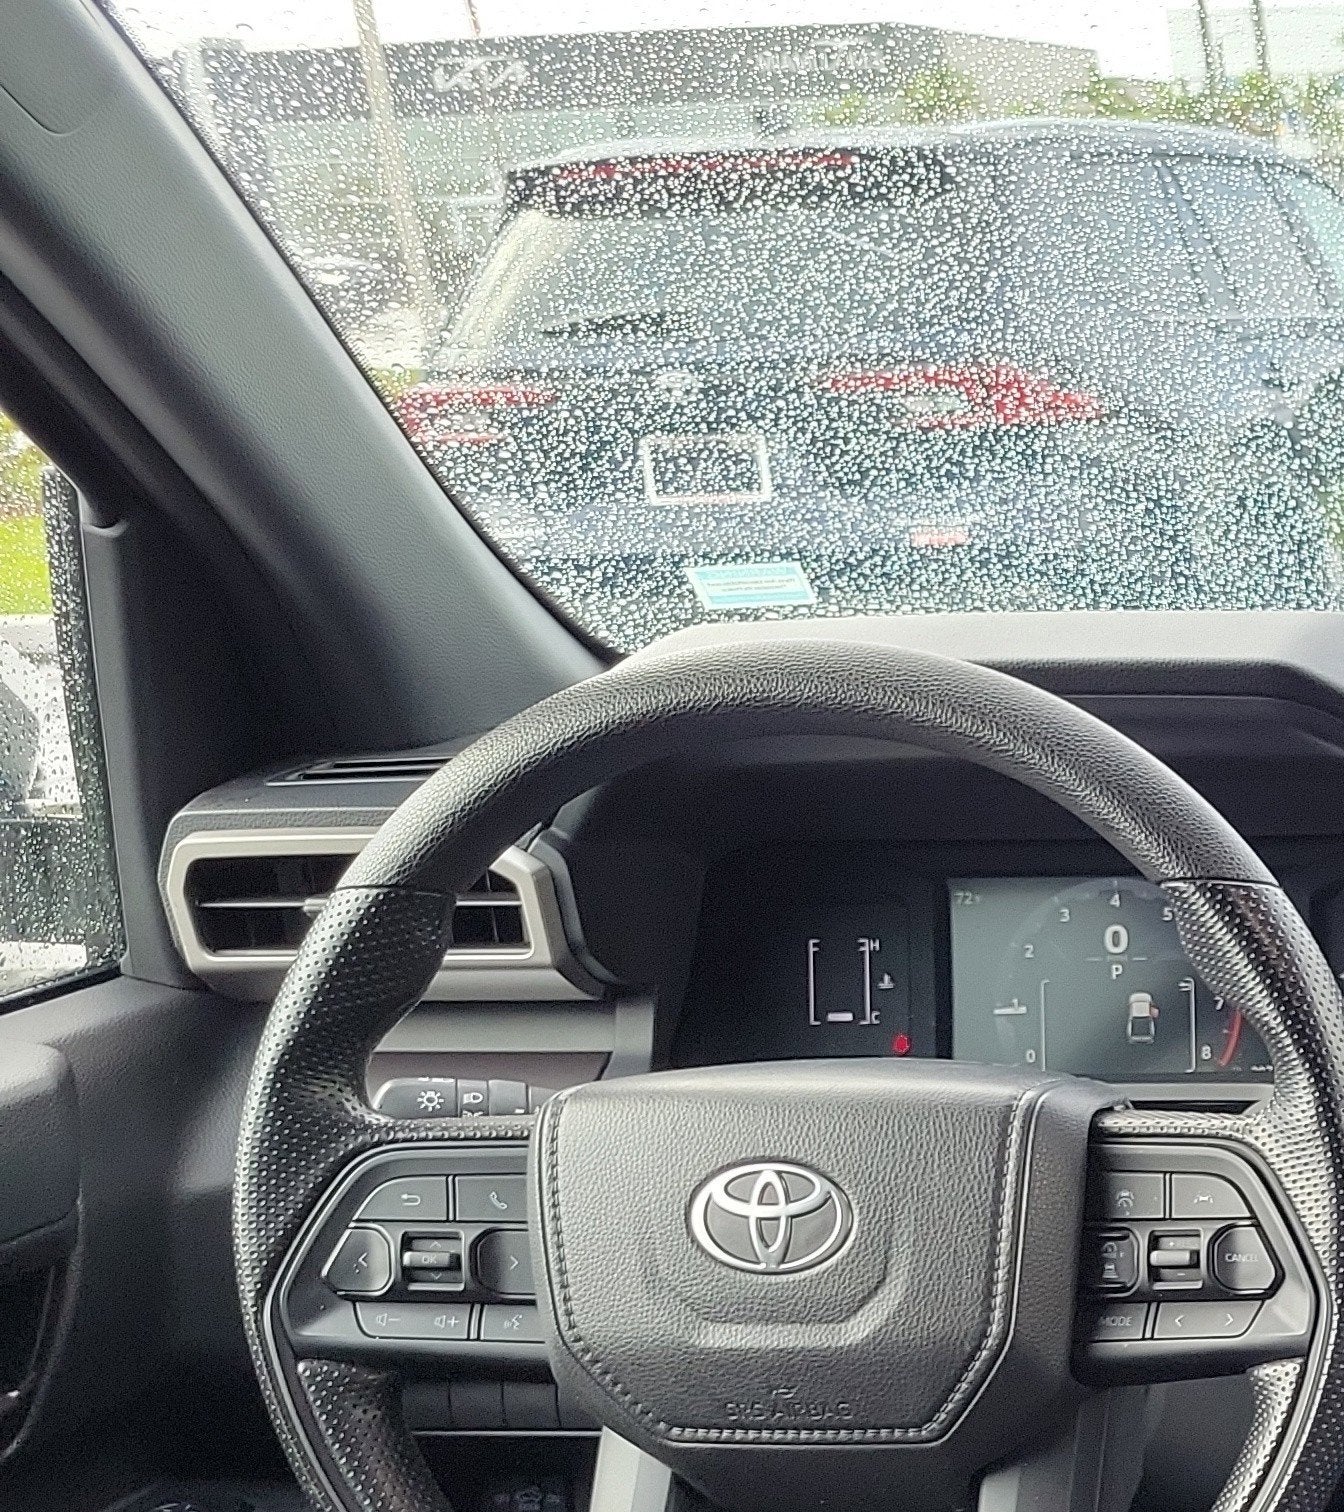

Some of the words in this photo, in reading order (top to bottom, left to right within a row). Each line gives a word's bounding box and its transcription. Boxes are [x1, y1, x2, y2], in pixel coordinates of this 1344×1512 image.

[1109, 894, 1121, 908] 4
[1058, 908, 1071, 923] 3
[1163, 906, 1174, 922] 5
[1104, 923, 1130, 955] 0
[1024, 944, 1036, 959] 2
[1111, 964, 1123, 980] P
[871, 1010, 880, 1024] C
[1026, 1049, 1037, 1064] 0
[1201, 1045, 1213, 1060] 8
[1225, 1252, 1259, 1263] CANCEL
[1100, 1315, 1133, 1327] MODE
